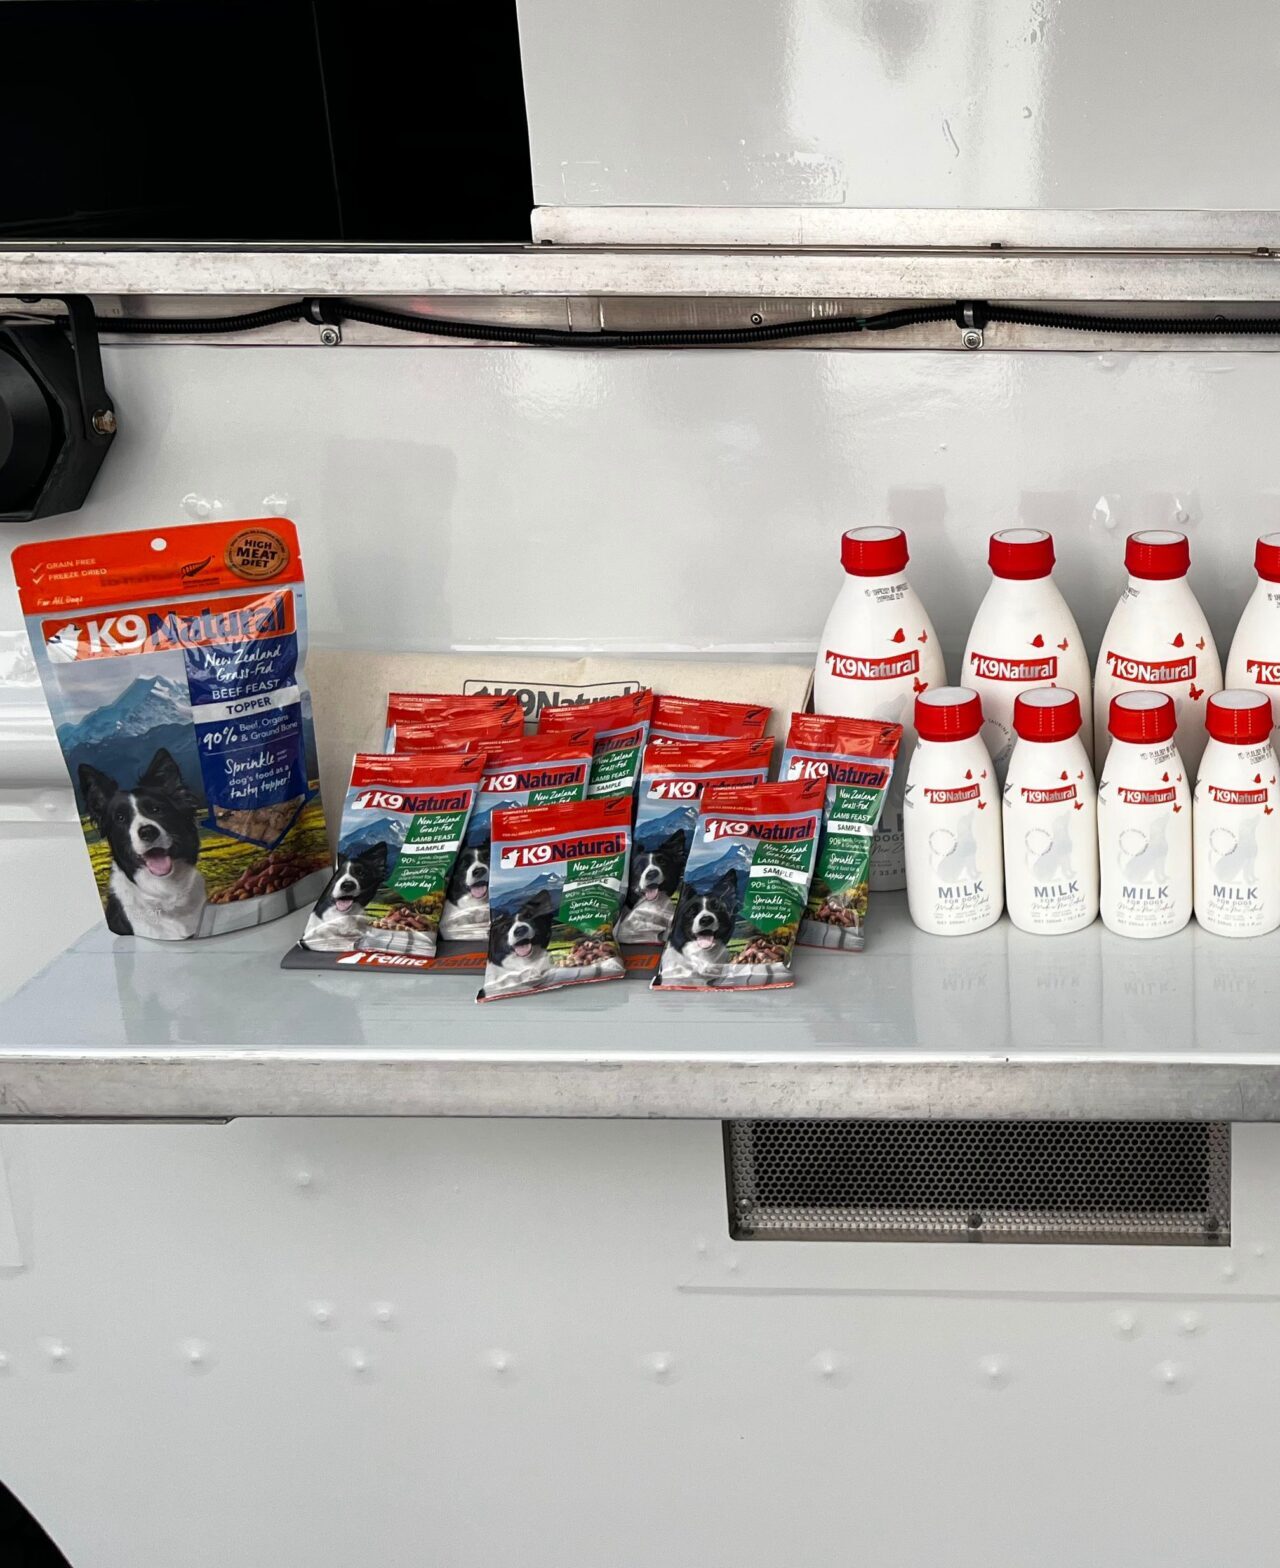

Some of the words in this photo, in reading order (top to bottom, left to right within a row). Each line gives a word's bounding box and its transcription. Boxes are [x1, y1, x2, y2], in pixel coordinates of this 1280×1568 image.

[244, 540, 272, 550] HIGH
[236, 547, 277, 560] MEAT
[46, 560, 74, 570] GRAIN
[75, 558, 96, 566] FREE
[241, 558, 269, 568] DIET
[48, 571, 80, 581] FREEZE
[86, 595, 286, 654] K9Natural
[204, 652, 232, 669] New
[233, 644, 282, 663] Zealand
[216, 661, 274, 682] Grass-Fed
[835, 656, 916, 678] K9Natural
[979, 658, 1054, 679] K9Natural
[1117, 659, 1193, 683] K9Natural
[212, 686, 243, 700] BEEF
[246, 678, 281, 694] FEAST
[226, 696, 272, 716] TOPPER
[203, 726, 238, 750] 90%
[261, 714, 289, 728] Organs
[241, 733, 249, 742] &
[250, 728, 280, 741] Ground
[280, 720, 298, 732] Bone
[224, 751, 275, 776] Sprinkle
[229, 774, 254, 788] dog's
[254, 768, 275, 781] food
[276, 768, 284, 776] as
[488, 768, 580, 792] K9Natural
[611, 769, 630, 779] FEAST
[804, 760, 884, 786] K9Natural
[230, 786, 258, 799] tasty
[261, 770, 292, 792] topper!
[596, 780, 622, 791] SAMPLE
[372, 791, 468, 812] K9Natural
[550, 788, 578, 800] Zealand
[850, 790, 878, 801] Zealand
[932, 785, 978, 802] K9Natural
[1029, 786, 1074, 802] K9Natural
[1127, 790, 1175, 804] K9Natural
[1216, 790, 1266, 804] K9Natural
[417, 816, 434, 826] New
[833, 812, 850, 821] LAMB
[850, 813, 872, 823] FEAST
[720, 820, 812, 840] K9Natural
[837, 824, 862, 832] SAMPLE
[411, 834, 432, 843] LAMB
[433, 833, 456, 842] FEAST
[415, 844, 445, 852] SAMPLE
[522, 835, 620, 864] K9Natural
[757, 857, 780, 866] LAMB
[763, 867, 794, 879] SAMPLE
[938, 880, 984, 898] MILK
[1034, 880, 1079, 898] MILK
[1122, 886, 1168, 900] MILK
[1213, 884, 1258, 900] MILK
[366, 952, 428, 967] Feline
